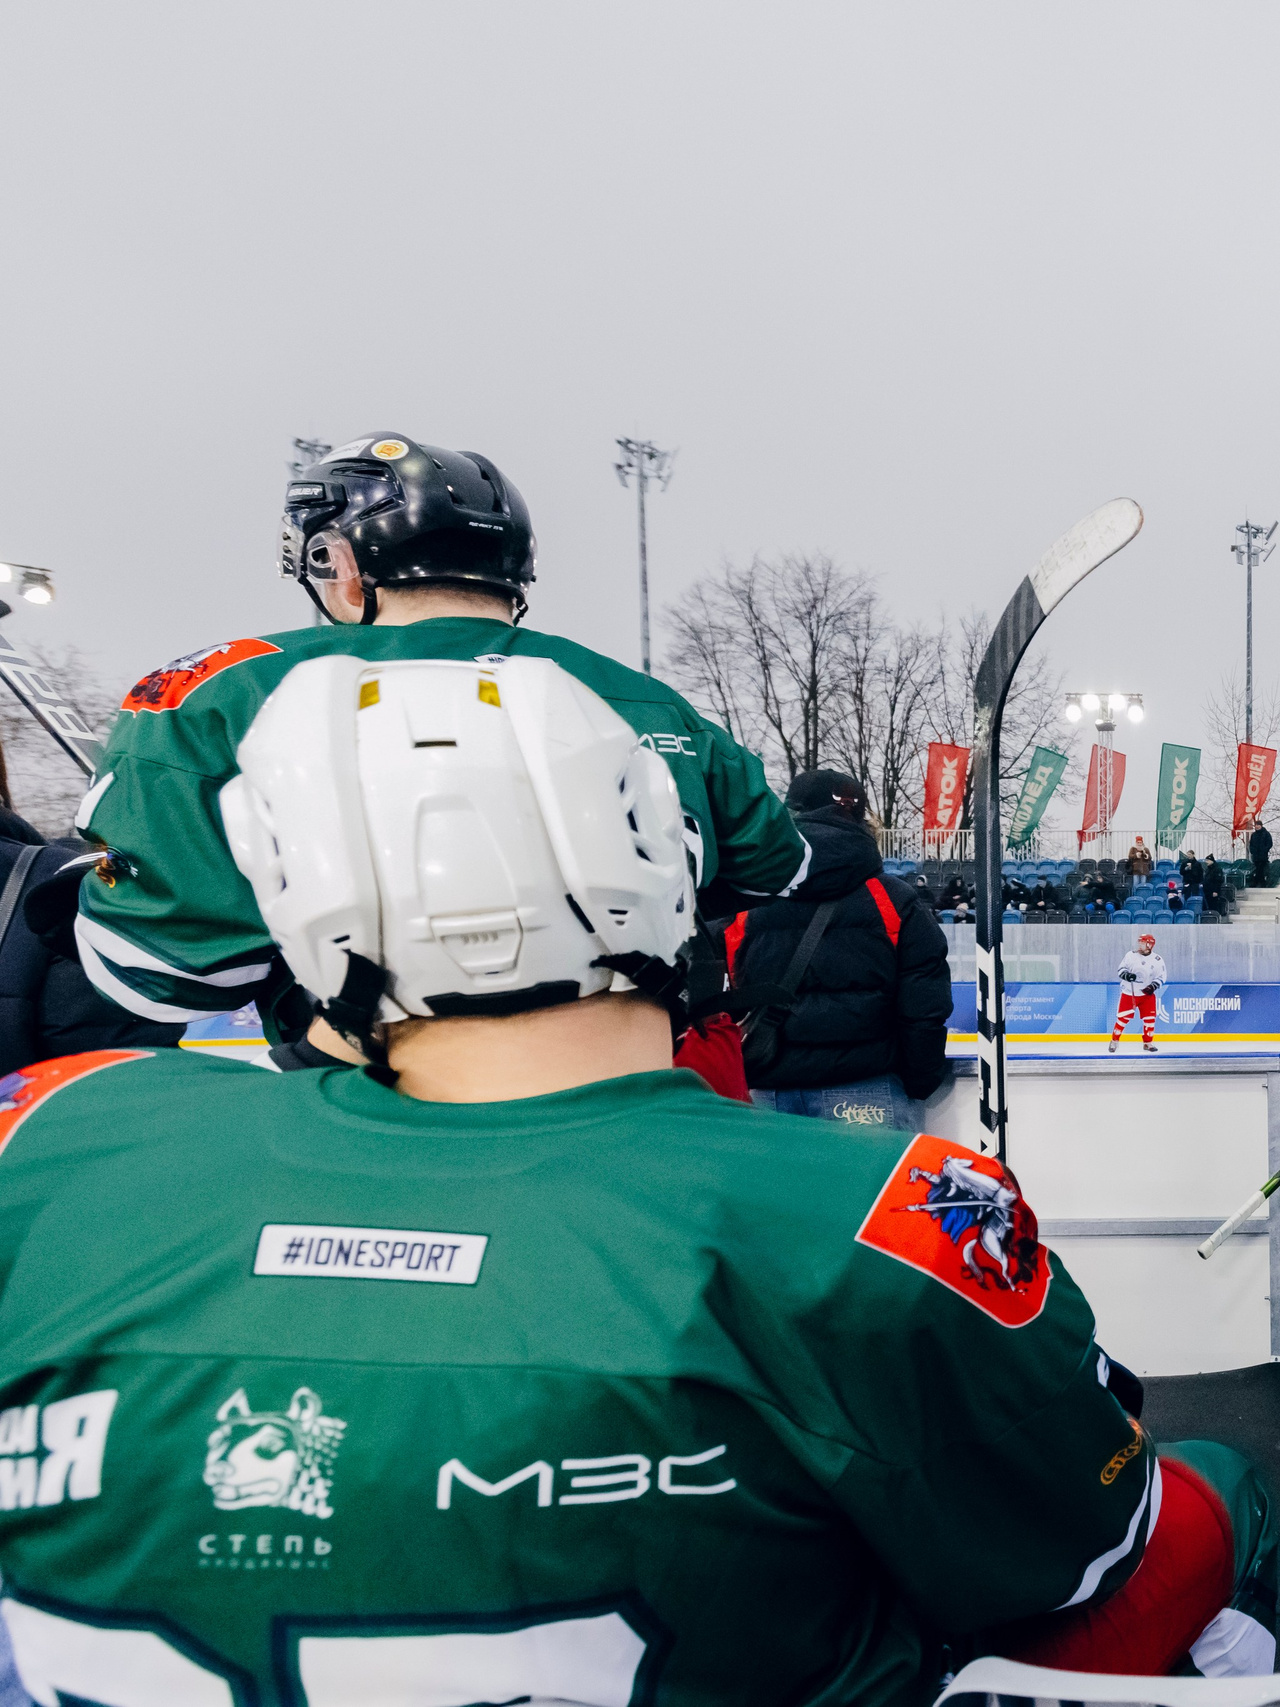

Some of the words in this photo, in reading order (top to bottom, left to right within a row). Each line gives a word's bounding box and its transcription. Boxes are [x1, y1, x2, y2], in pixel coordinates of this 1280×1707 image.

[1173, 994, 1241, 1011] МОСКОВСКИЙ
[1173, 1011, 1205, 1024] СПОРТ
[199, 1533, 333, 1556] СТЕПЬ
